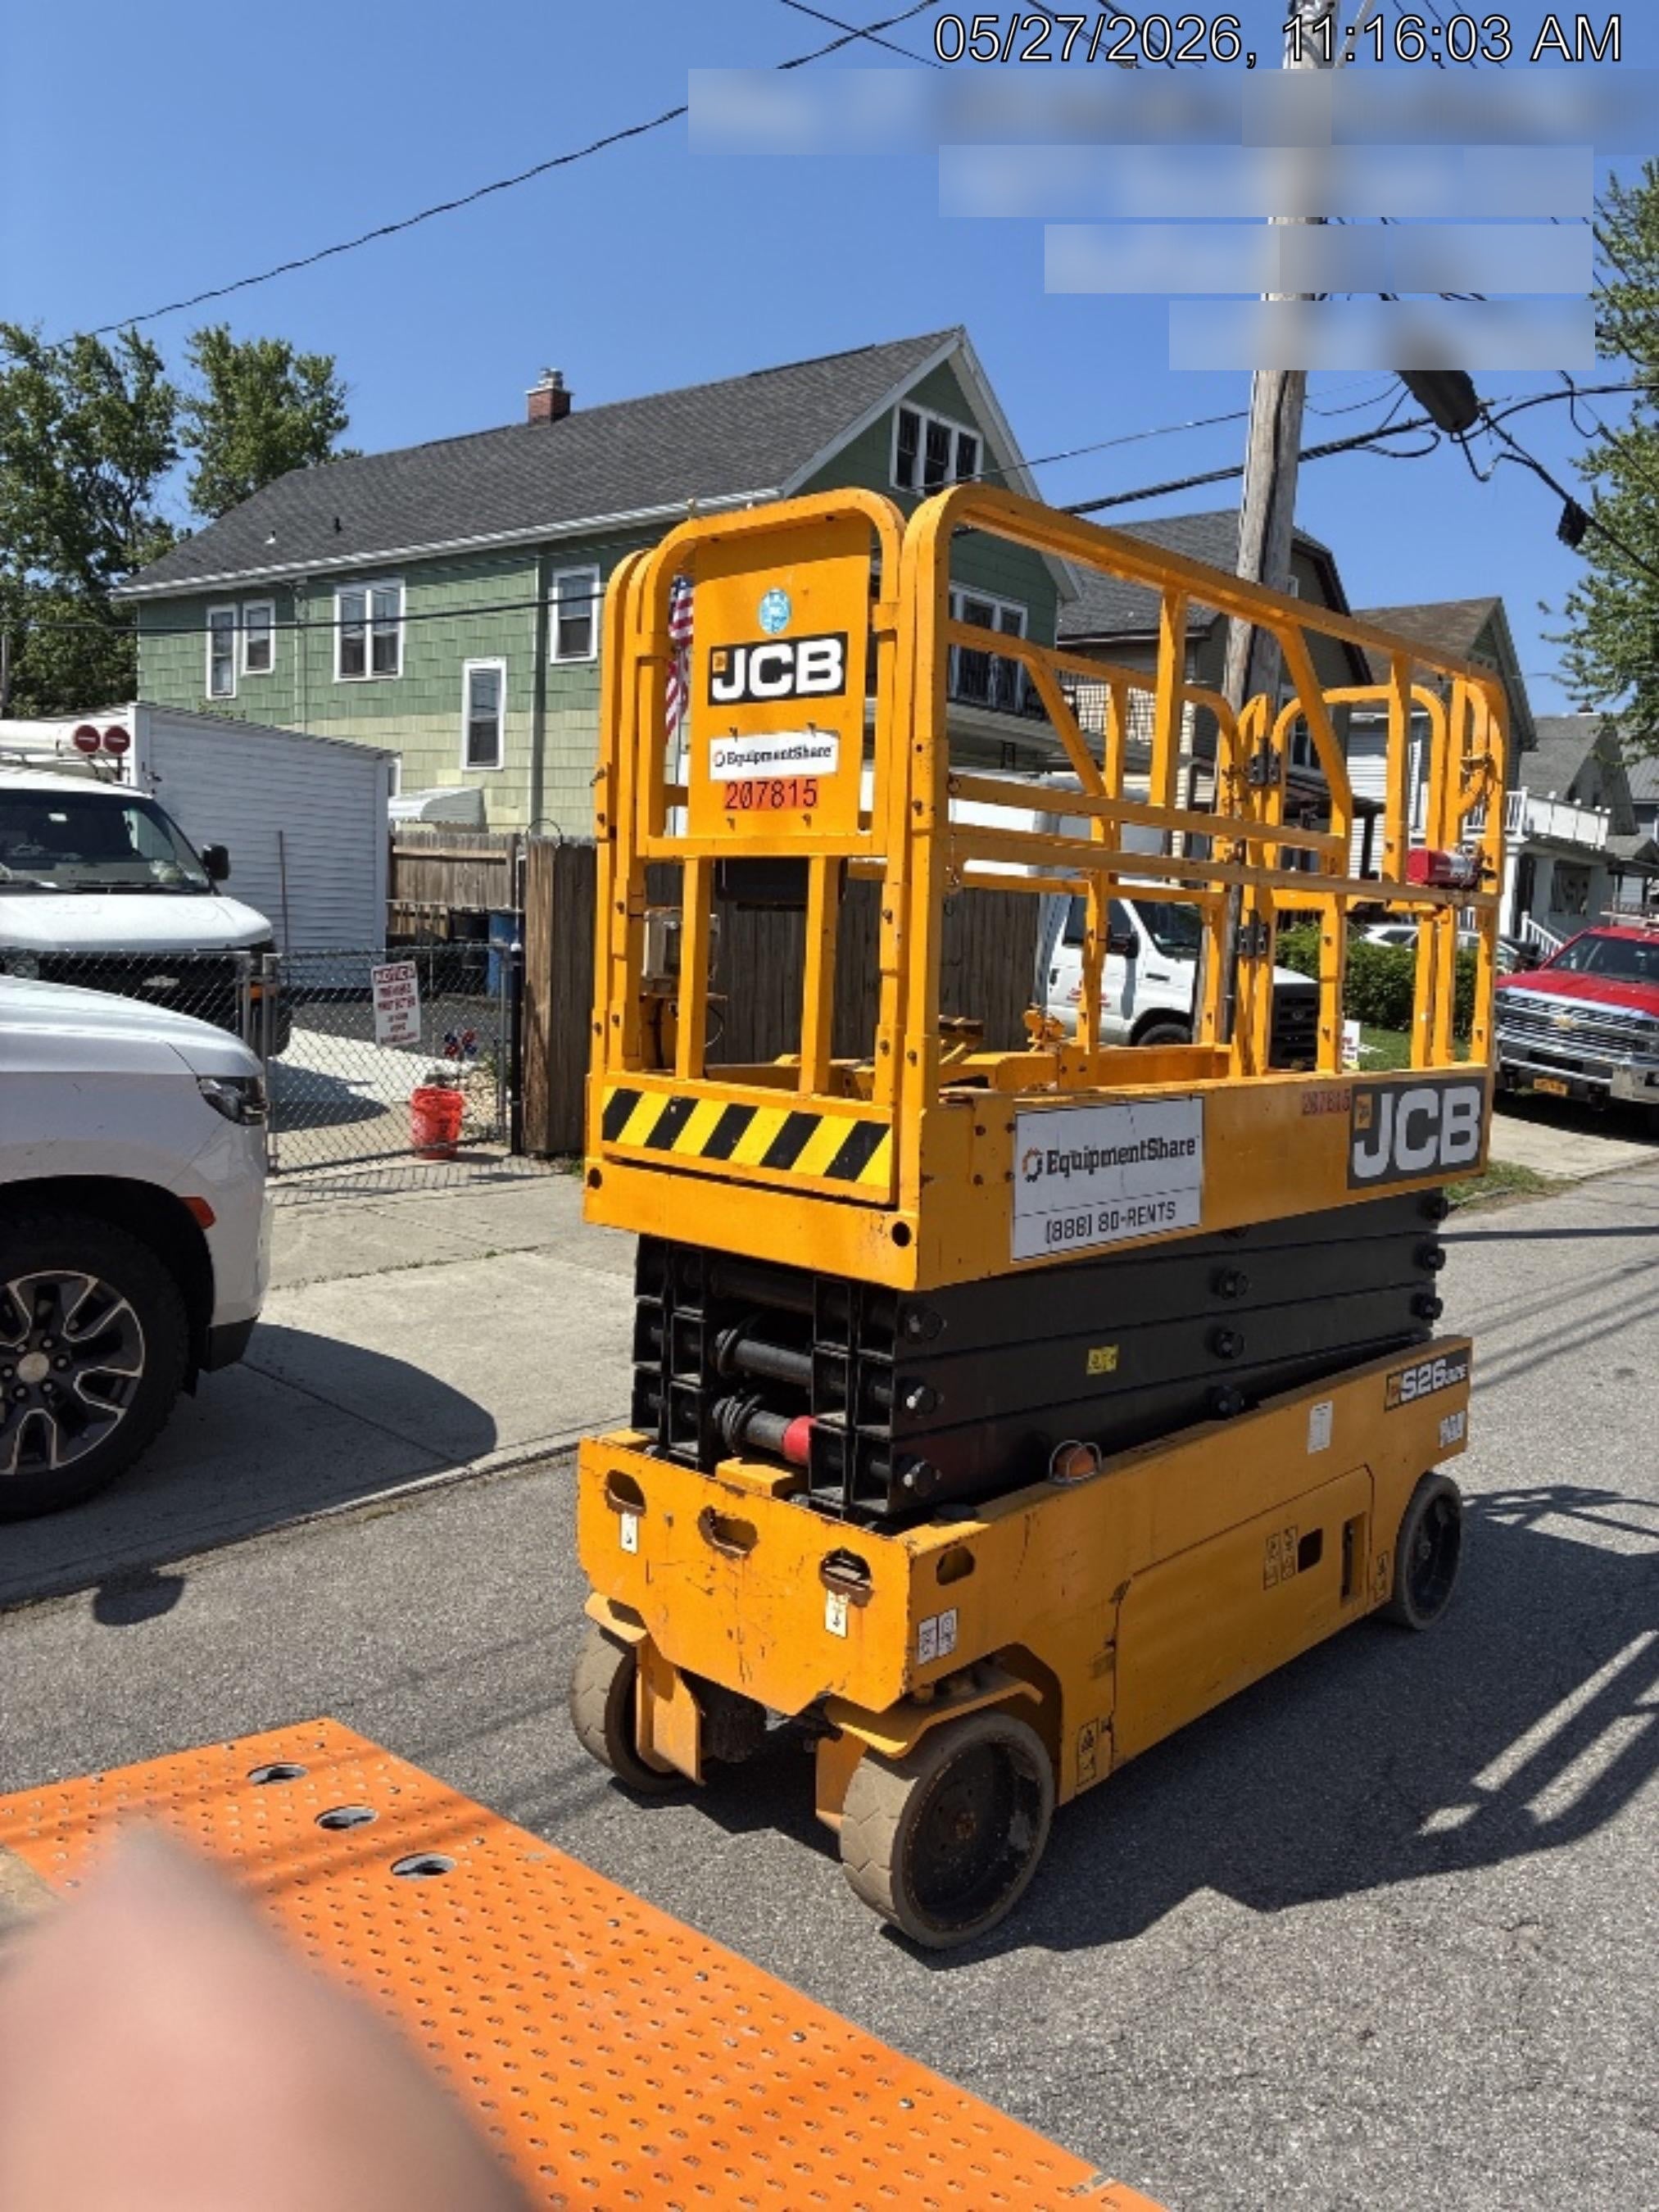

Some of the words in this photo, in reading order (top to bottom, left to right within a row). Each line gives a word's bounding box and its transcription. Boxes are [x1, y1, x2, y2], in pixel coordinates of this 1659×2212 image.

[711, 638, 842, 701] JCB
[727, 744, 832, 767] EquipmentShare
[724, 778, 818, 809] 207815
[1353, 1086, 1481, 1178] JCB
[1046, 1136, 1196, 1178] EquipmentShare
[1098, 1201, 1176, 1233] 80-RENTS
